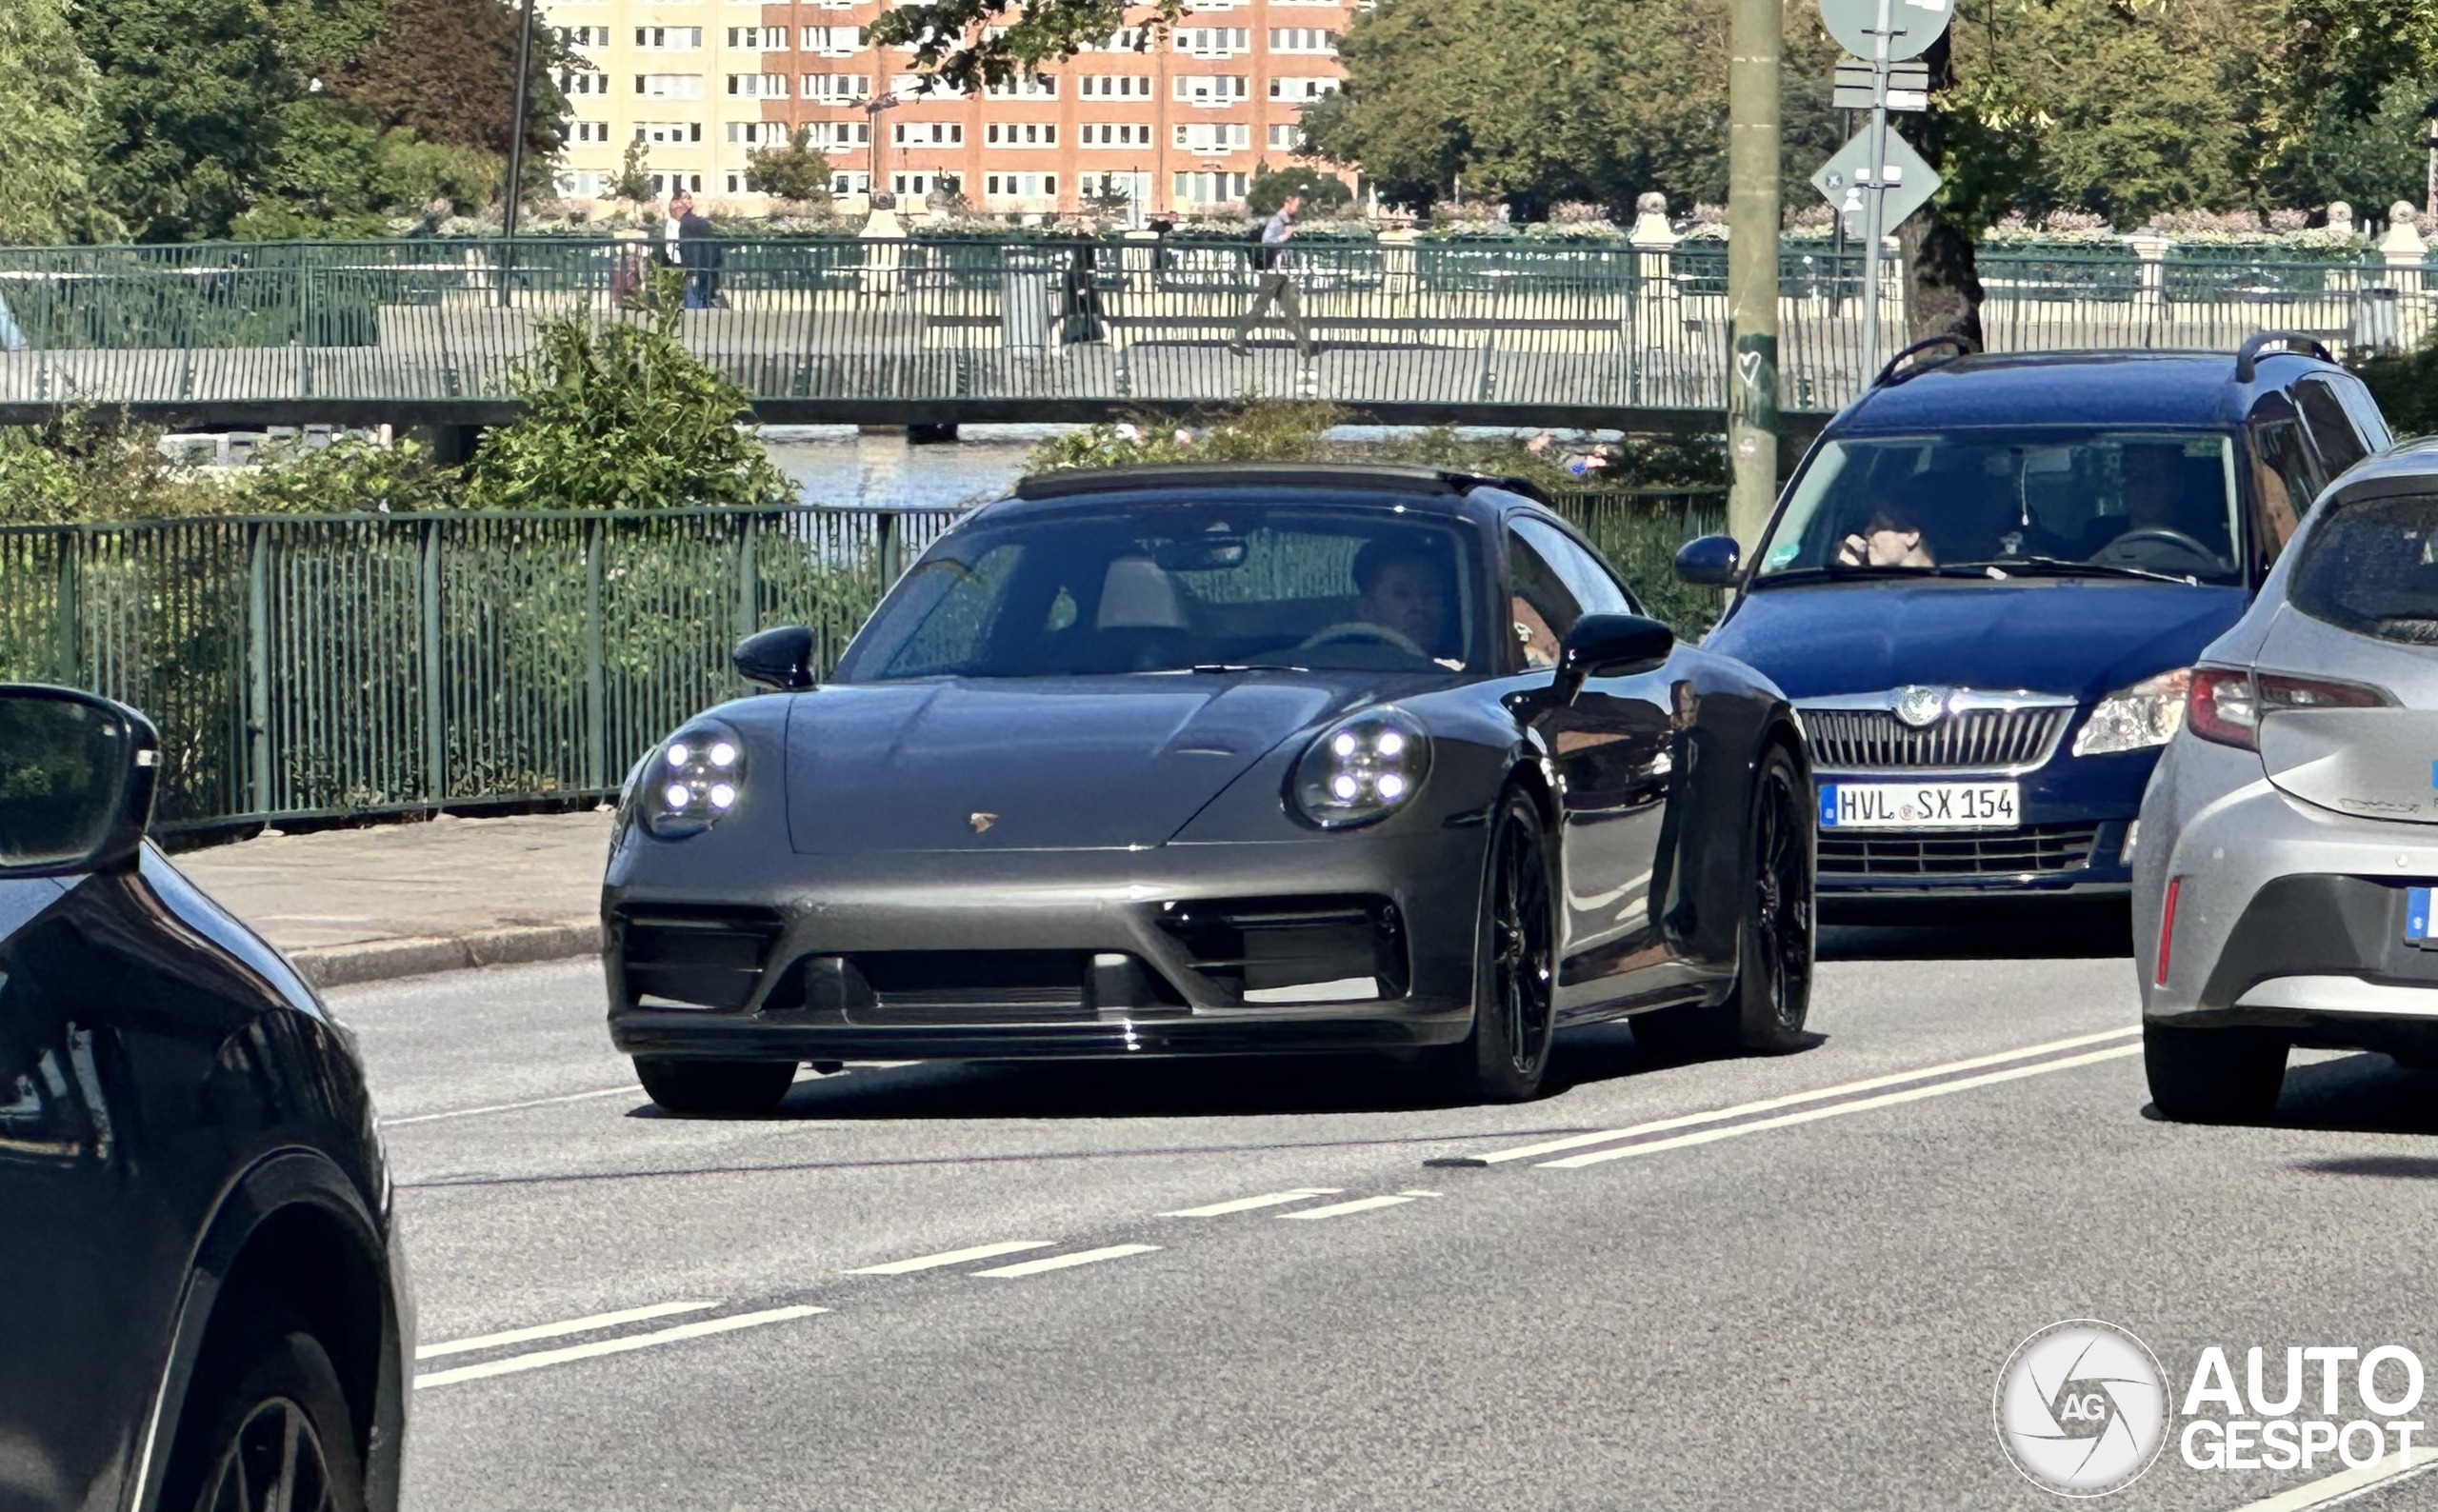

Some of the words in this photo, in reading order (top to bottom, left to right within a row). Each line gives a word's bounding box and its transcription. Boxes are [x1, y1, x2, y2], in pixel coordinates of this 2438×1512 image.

[1841, 790, 1894, 820] HVL
[1917, 789, 1952, 819] SX
[1961, 789, 2013, 819] 154
